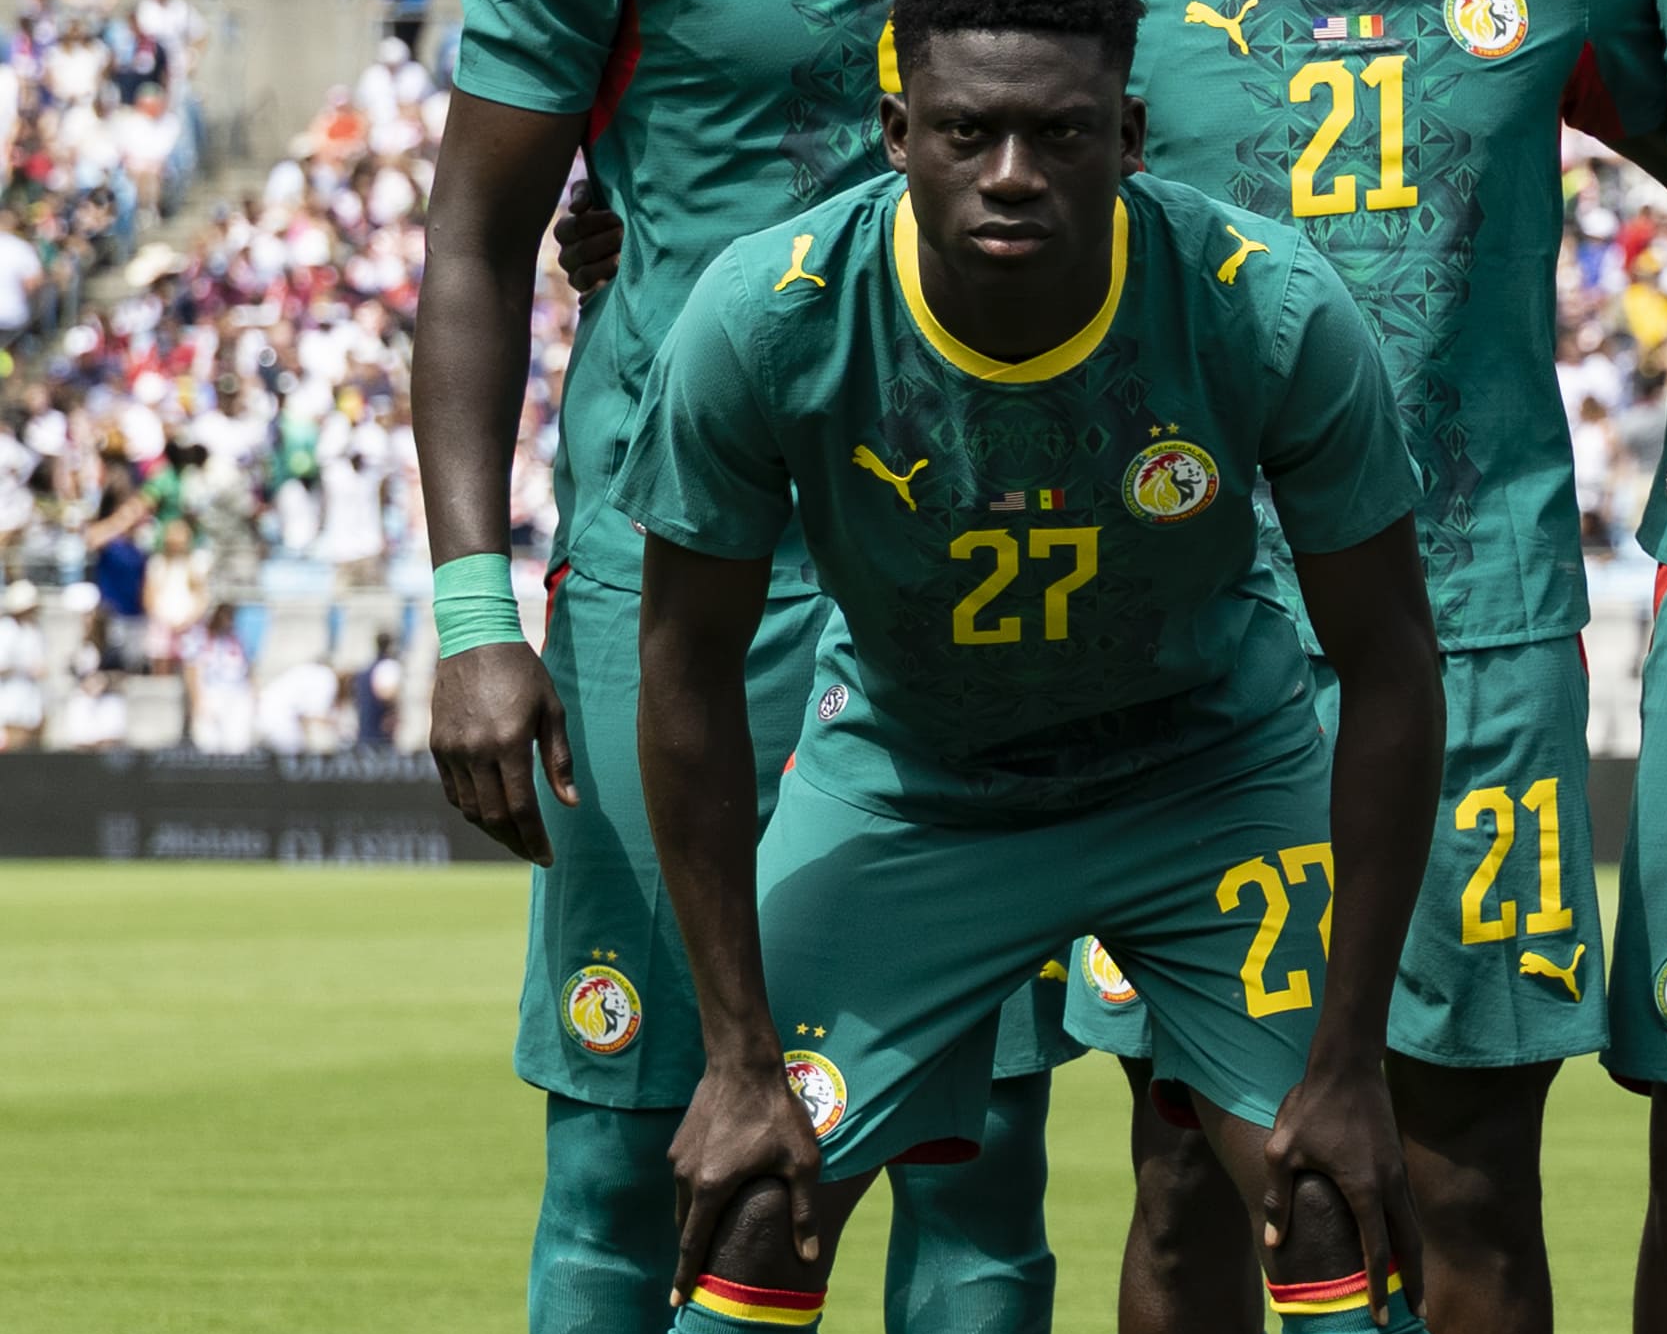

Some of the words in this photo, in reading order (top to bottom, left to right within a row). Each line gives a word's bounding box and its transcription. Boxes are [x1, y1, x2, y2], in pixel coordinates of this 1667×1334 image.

[1289, 55, 1418, 217] 21
[949, 526, 1100, 645] 27
[1455, 777, 1573, 945] 21
